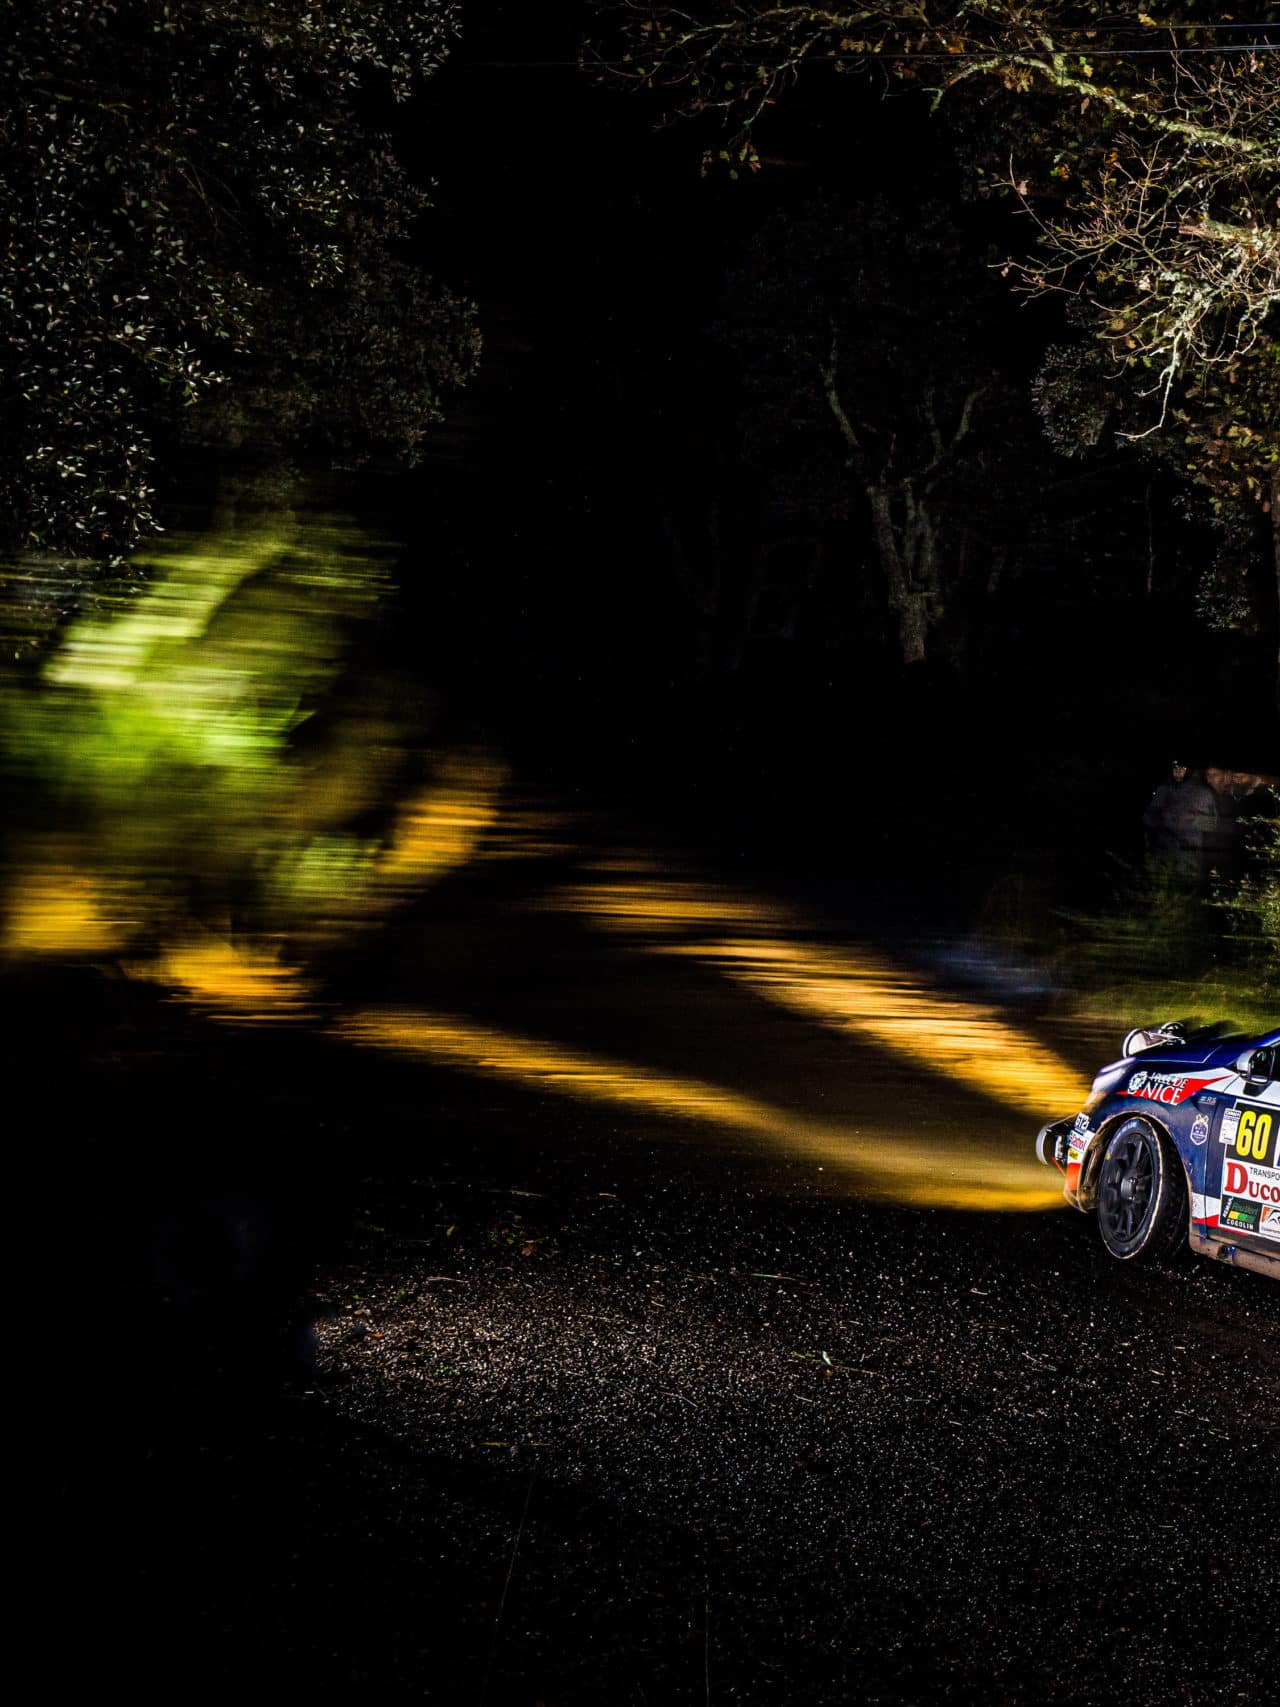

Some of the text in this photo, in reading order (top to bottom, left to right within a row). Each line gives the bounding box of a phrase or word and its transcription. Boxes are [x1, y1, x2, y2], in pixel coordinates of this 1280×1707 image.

[1139, 1080, 1184, 1106] NICE
[1236, 1110, 1272, 1160] 60
[1226, 1219, 1254, 1231] COGOLIN
